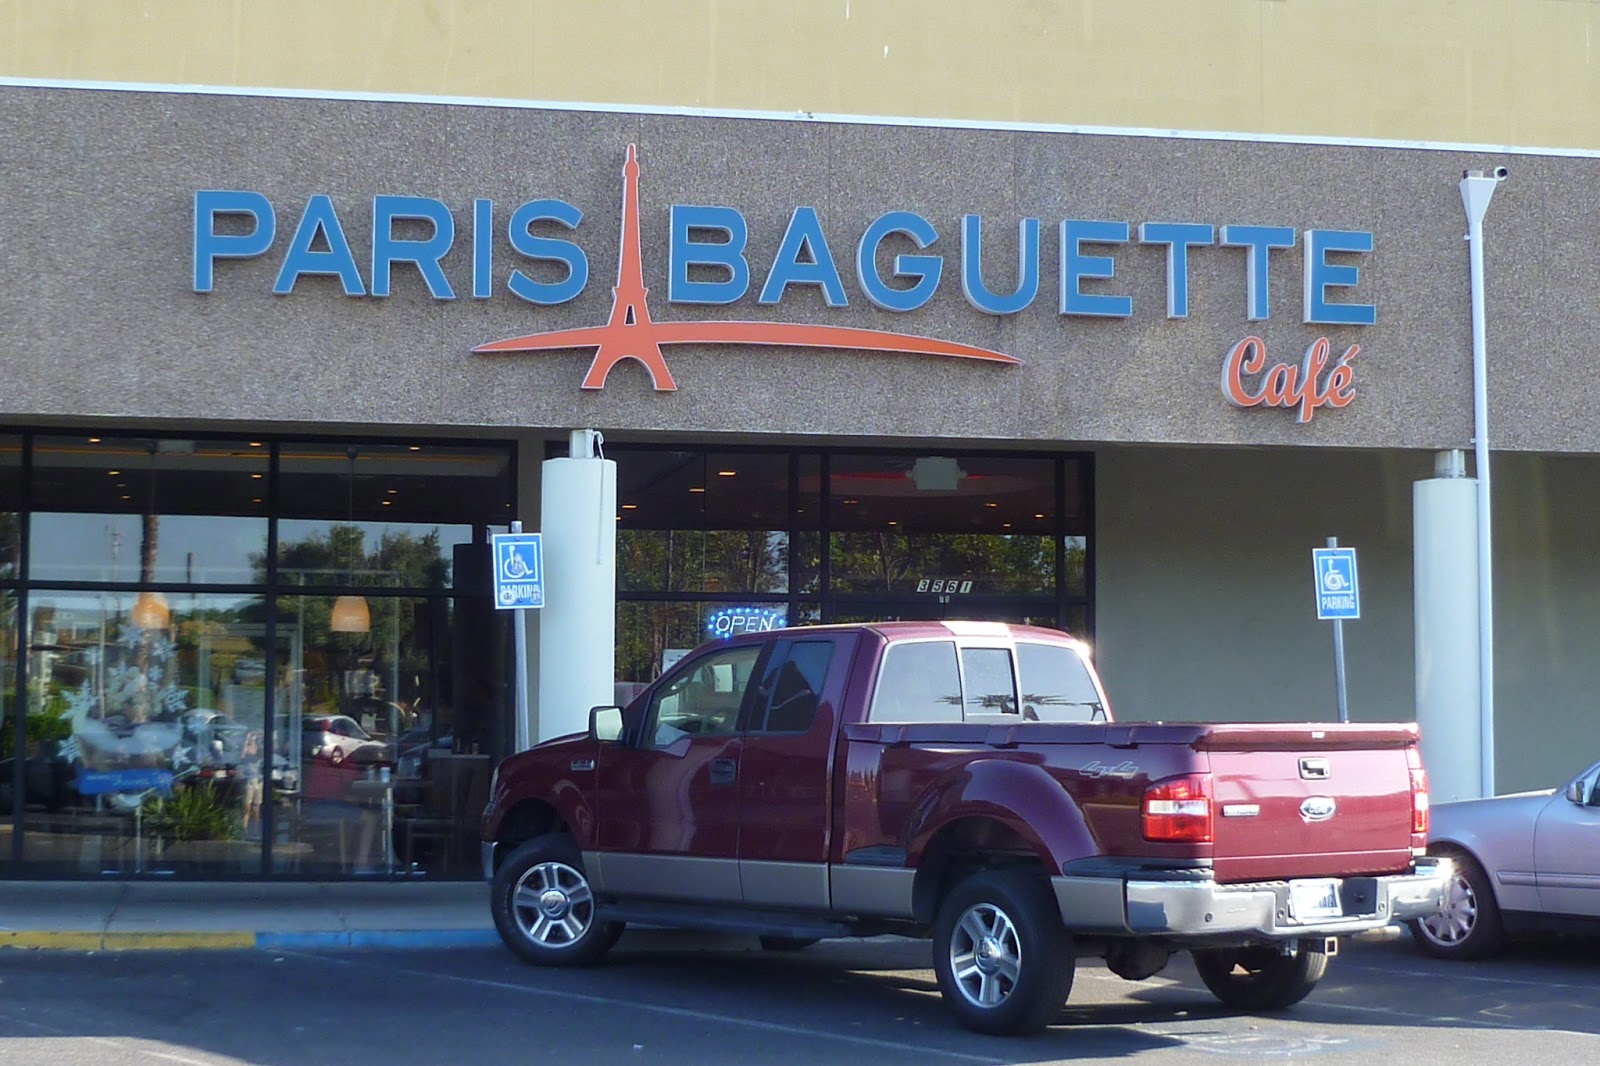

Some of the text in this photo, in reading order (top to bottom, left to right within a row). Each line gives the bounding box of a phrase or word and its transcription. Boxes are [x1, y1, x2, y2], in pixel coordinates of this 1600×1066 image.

[193, 189, 1377, 326] PARIS BAGUETTE
[1221, 335, 1360, 424] Café
[918, 580, 971, 593] 3561
[1321, 594, 1355, 610] PARKING
[716, 615, 775, 633] OPEN
